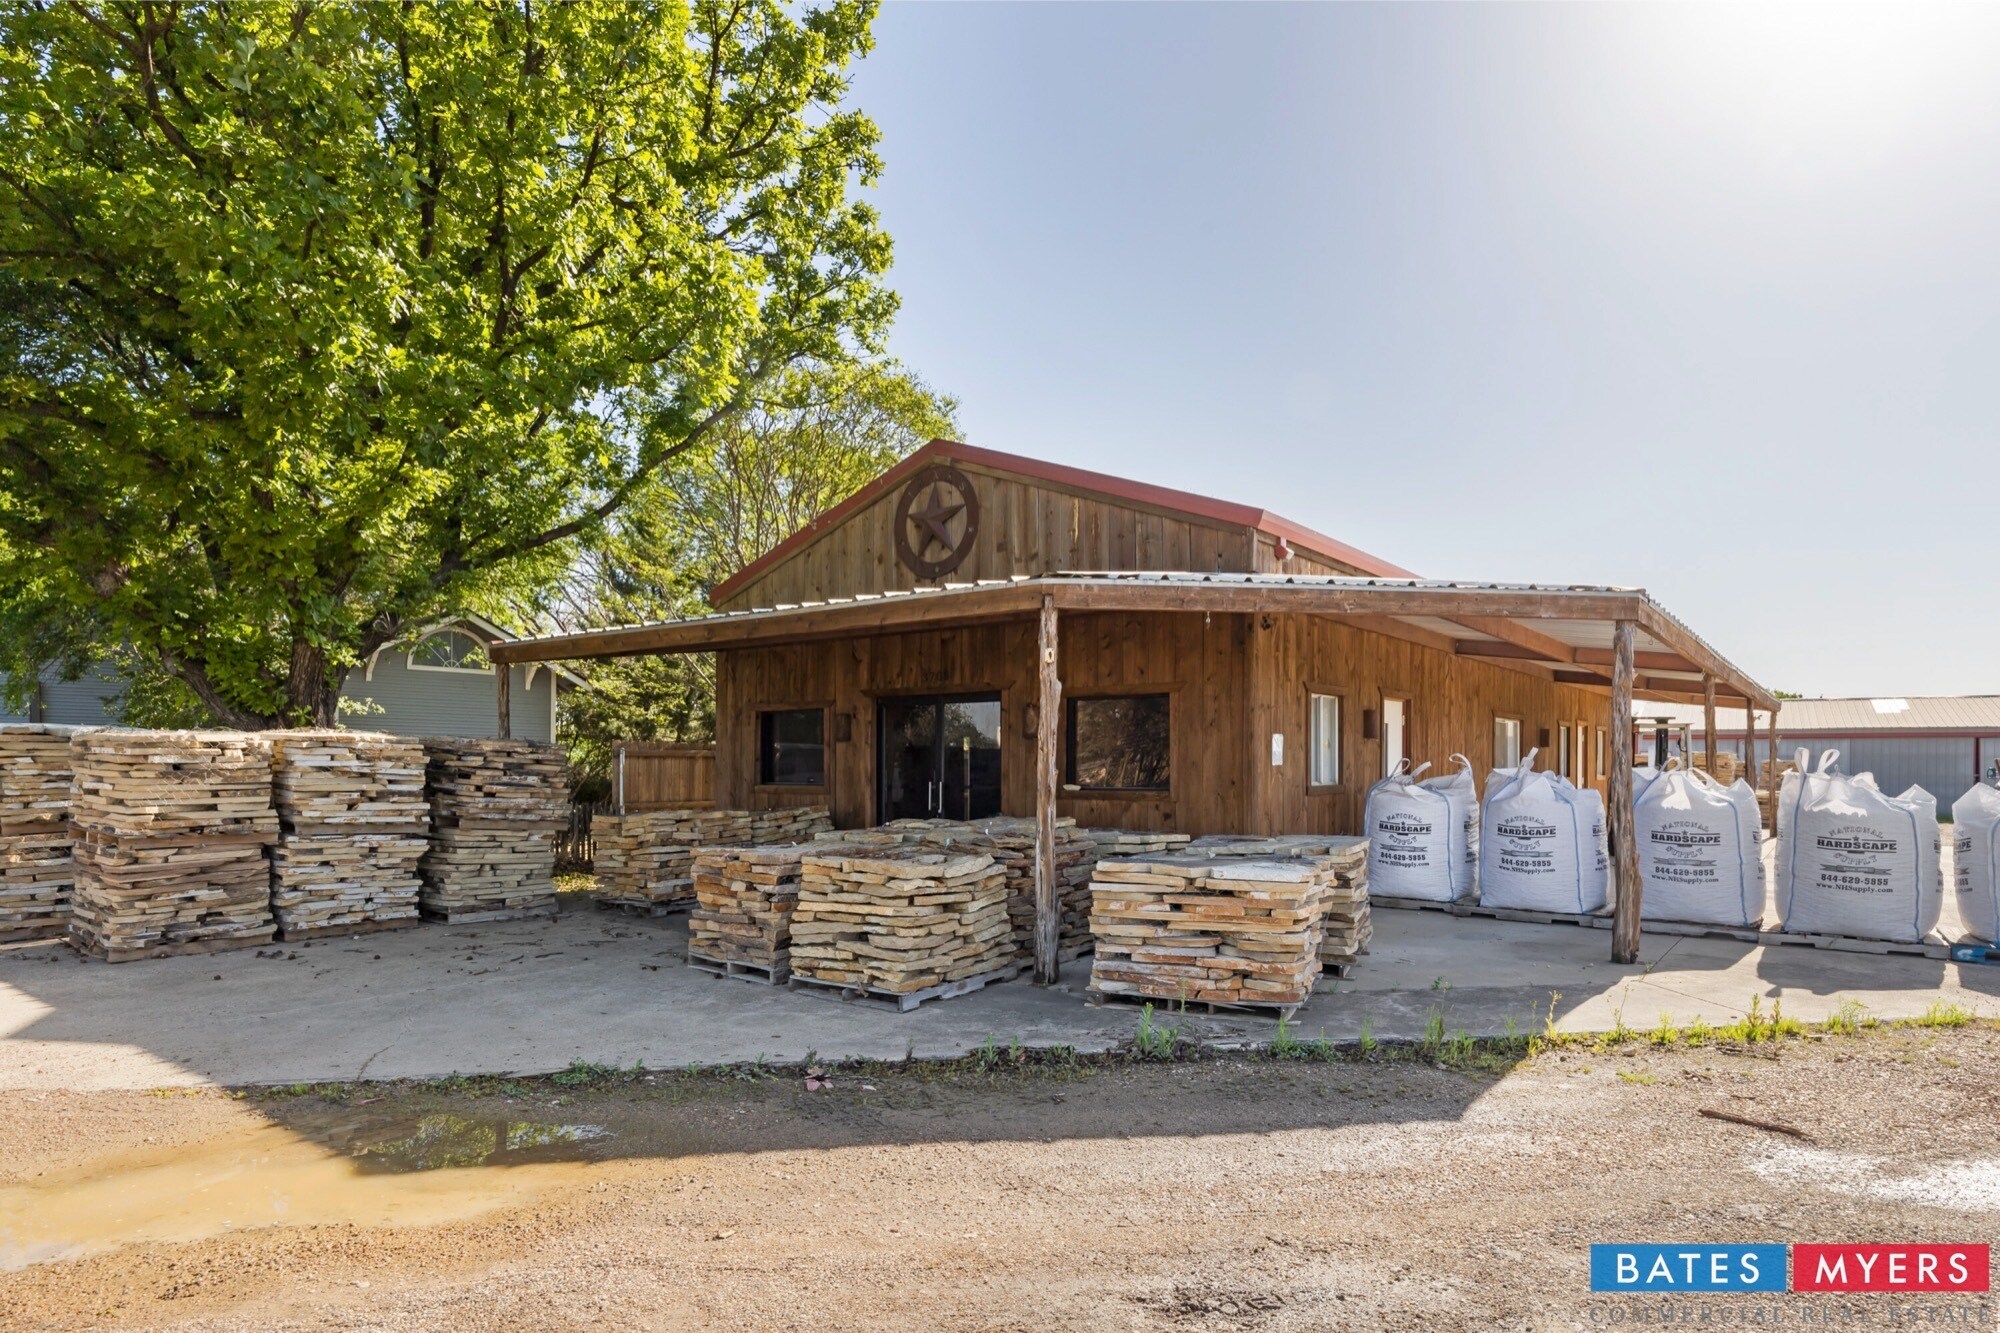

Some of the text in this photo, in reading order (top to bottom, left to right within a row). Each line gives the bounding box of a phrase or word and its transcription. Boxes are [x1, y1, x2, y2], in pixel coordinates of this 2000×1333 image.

[1386, 813, 1423, 823] NATIONAL
[1504, 815, 1545, 825] NATIONAL
[1379, 823, 1432, 832] HARDSCAPE
[1497, 826, 1556, 835] HARDSCAPE
[1661, 821, 1709, 832] NATIONAL
[1651, 833, 1721, 843] HARDSCAPE
[1828, 826, 1884, 839] NATIONAL
[1388, 834, 1418, 845] SUPPLY
[1509, 839, 1541, 850] SUPPLY
[1817, 839, 1897, 850] HARDSCAPE
[1665, 846, 1704, 858] SUPPLY
[1378, 859, 1430, 868] www.NHSupply.com
[1833, 852, 1878, 865] SUPPLY
[1498, 865, 1556, 875] www.NHSupply.com
[1655, 866, 1715, 876] 844-629-5855
[1651, 874, 1719, 885] www.NHSupply.com
[1821, 874, 1889, 886] 844-629-5855
[1816, 882, 1893, 893] www.NHSupply.com
